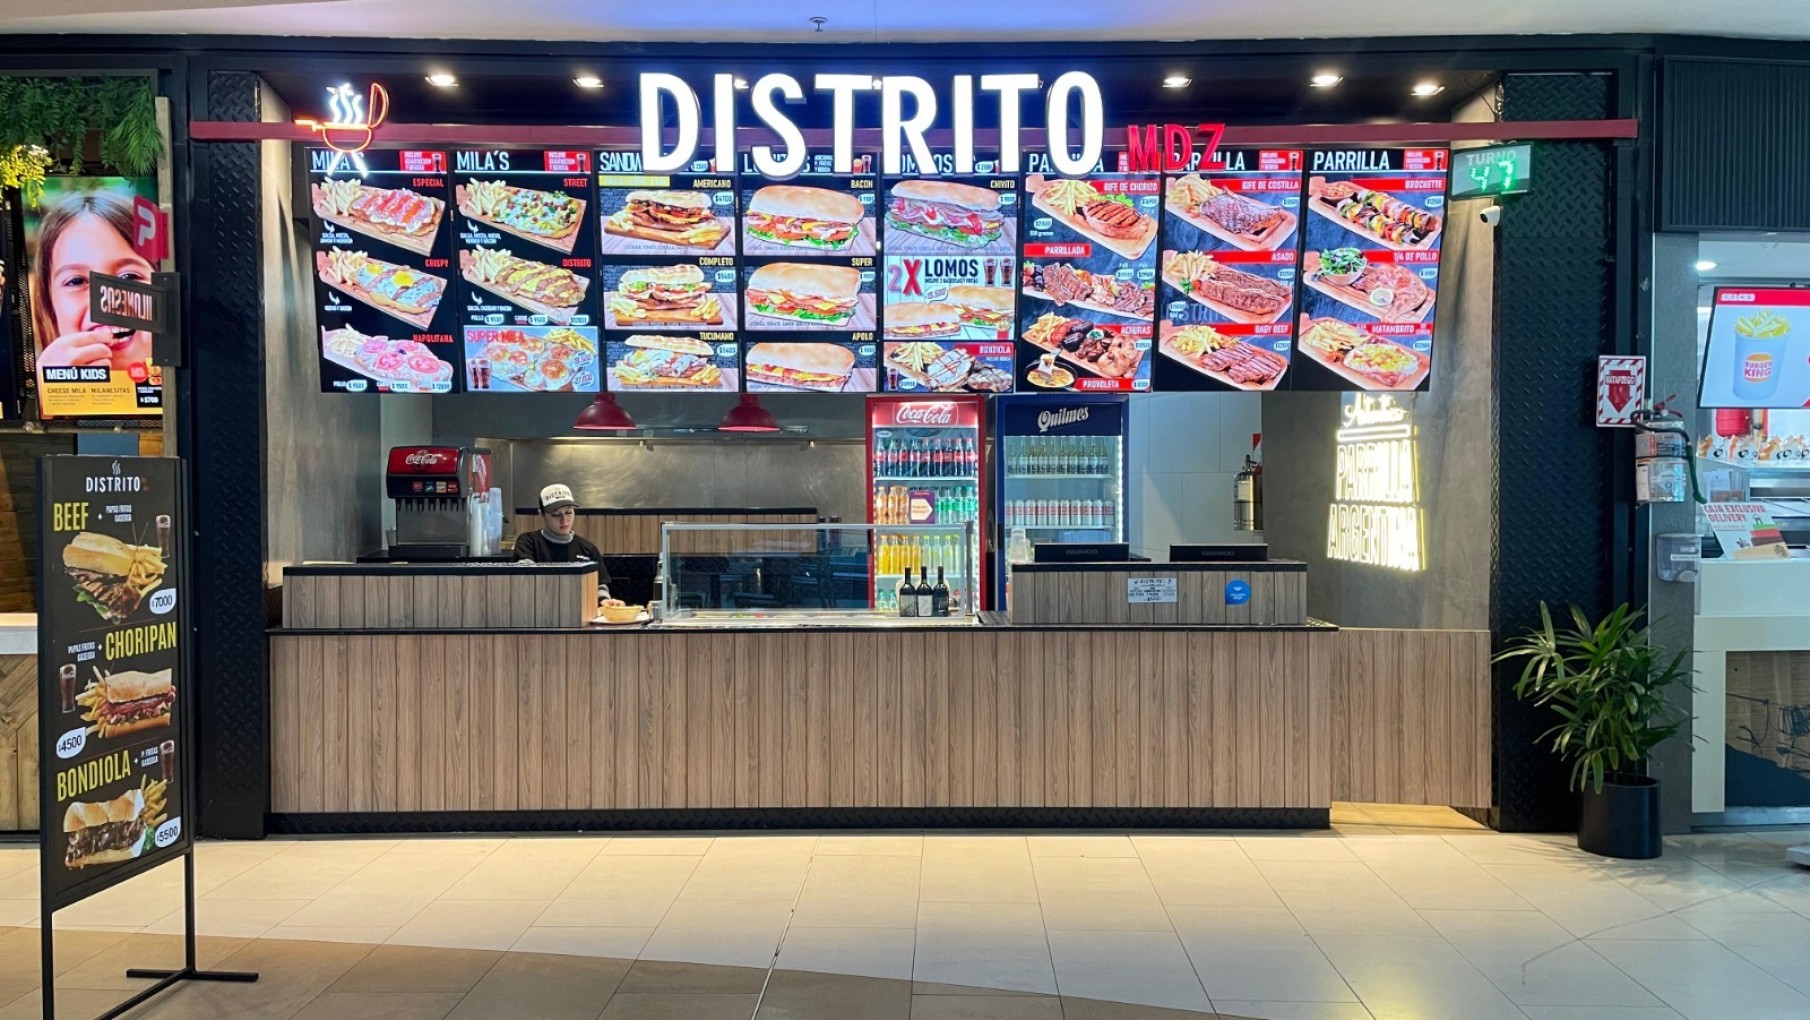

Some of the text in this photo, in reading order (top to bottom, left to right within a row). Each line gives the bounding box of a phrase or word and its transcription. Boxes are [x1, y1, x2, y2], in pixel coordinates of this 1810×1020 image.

[640, 71, 1104, 179] DISTRITO
[1128, 123, 1226, 172] MDZ
[1314, 151, 1390, 170] PARRILLA
[1466, 150, 1517, 165] TURNO
[1471, 161, 1513, 191] 47
[413, 178, 444, 187] ESPECIAL
[564, 178, 587, 187] STREET
[693, 179, 731, 188] AMERICANO
[851, 180, 873, 189] BACON
[991, 180, 1015, 189] CHIVITO
[1104, 183, 1158, 191] BIFE DE CHORIZO
[1242, 181, 1299, 190] BIFE DE COSTILLA
[1405, 180, 1442, 189] BROCHETTE
[1045, 246, 1085, 255] PARRILLADA
[1271, 252, 1294, 261] ASADO
[1406, 252, 1414, 260] DE
[1415, 252, 1437, 260] POLLO
[425, 258, 449, 267] CRISPY
[699, 257, 733, 266] COMPLETO
[851, 257, 873, 266] SUPER
[925, 259, 979, 277] LOMOS
[1121, 326, 1151, 335] ACHURAS
[1372, 325, 1415, 333] MATAMBRITO
[413, 334, 453, 343] NAPOLITANA
[467, 330, 499, 343] SUPER
[699, 332, 734, 340] TUCUMANO
[852, 332, 873, 340] APOLO
[979, 346, 1011, 354] BONDIOLA
[1745, 361, 1773, 369] BURGER
[46, 366, 107, 380] MENÚ KIDS
[1743, 368, 1772, 378] KING
[1083, 380, 1119, 388] PROVOLETA
[896, 403, 954, 424] Coca-Cola
[1038, 406, 1090, 433] Quilmes
[406, 453, 440, 465] Coca-Cola
[86, 476, 141, 492] DISTRITO
[1704, 504, 1767, 513] CAJA EXCLUSIVA
[54, 502, 89, 531] BEEF
[1708, 513, 1747, 522] DELIVERY
[105, 621, 177, 661] CHORIPAN
[57, 749, 131, 802] BONDIOLA
